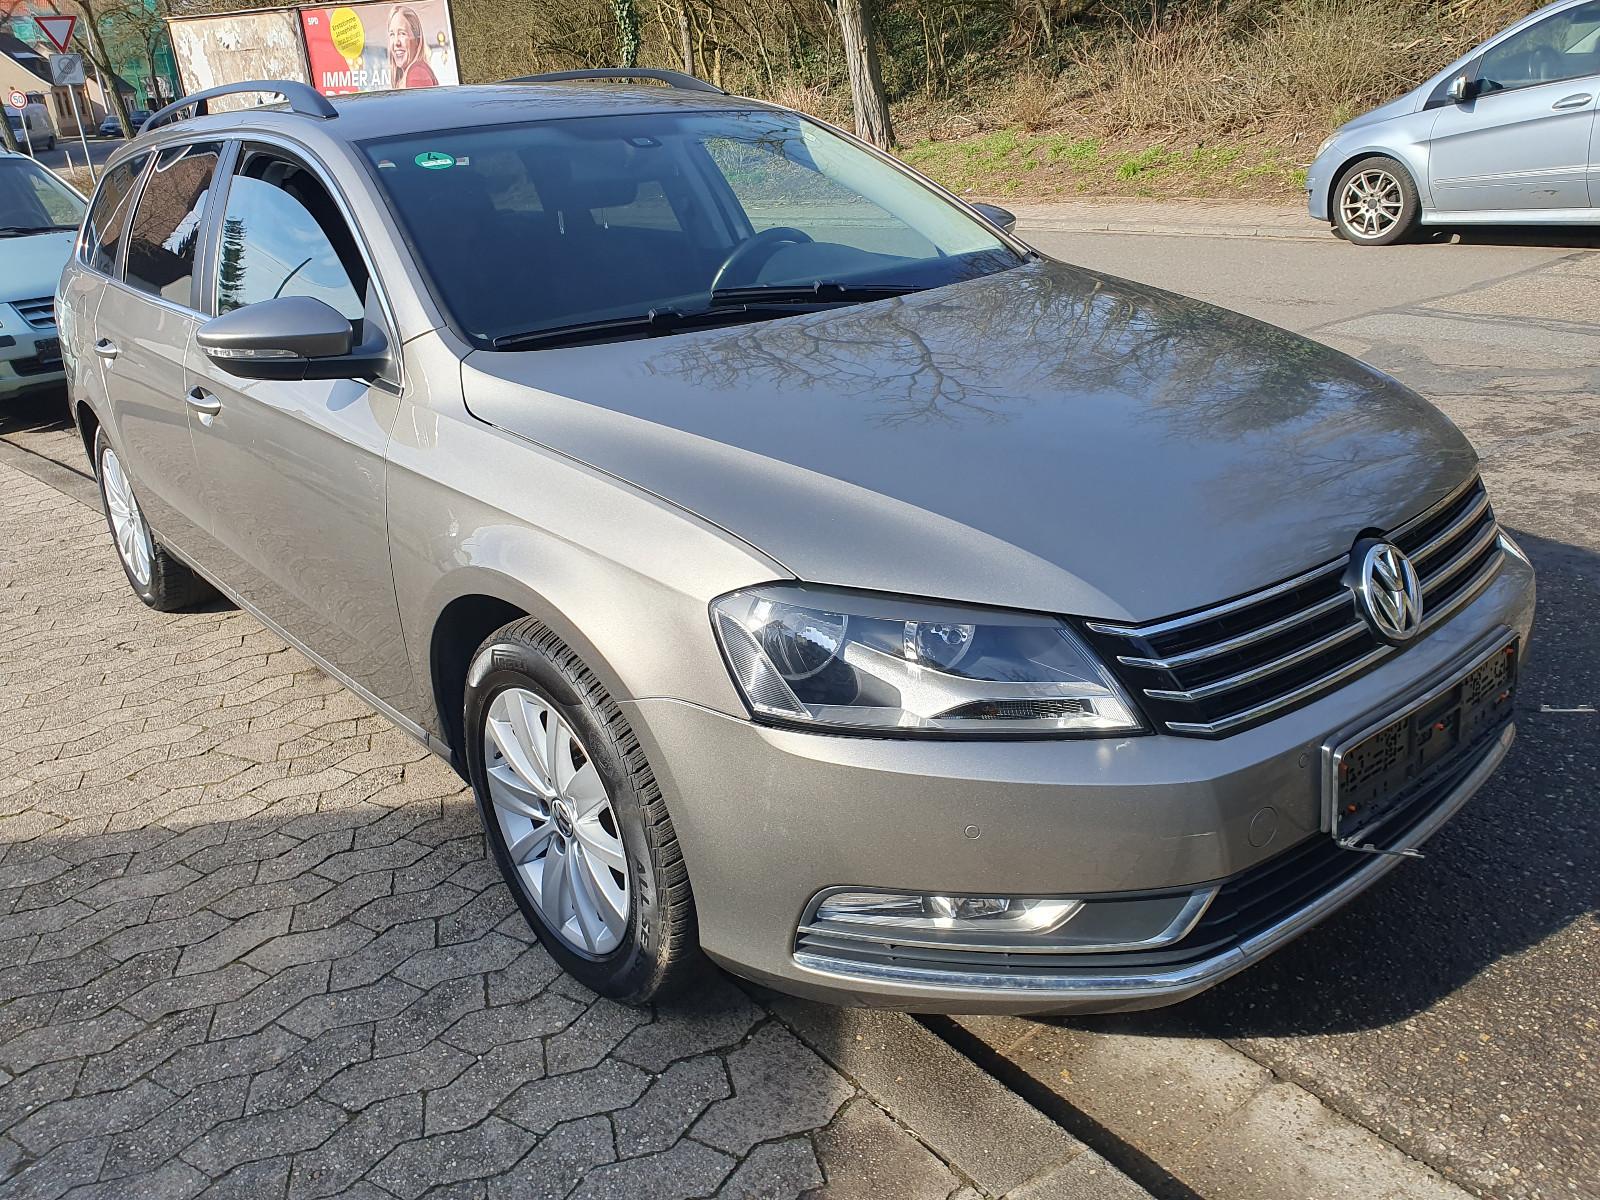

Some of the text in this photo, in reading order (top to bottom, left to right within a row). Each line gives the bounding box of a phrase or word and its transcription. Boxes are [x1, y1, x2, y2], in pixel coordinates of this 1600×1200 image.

[307, 17, 319, 26] SPD
[322, 69, 391, 88] IMMER AN
[13, 95, 23, 104] 50
[427, 152, 439, 160] 4
[633, 854, 650, 907] ALL
